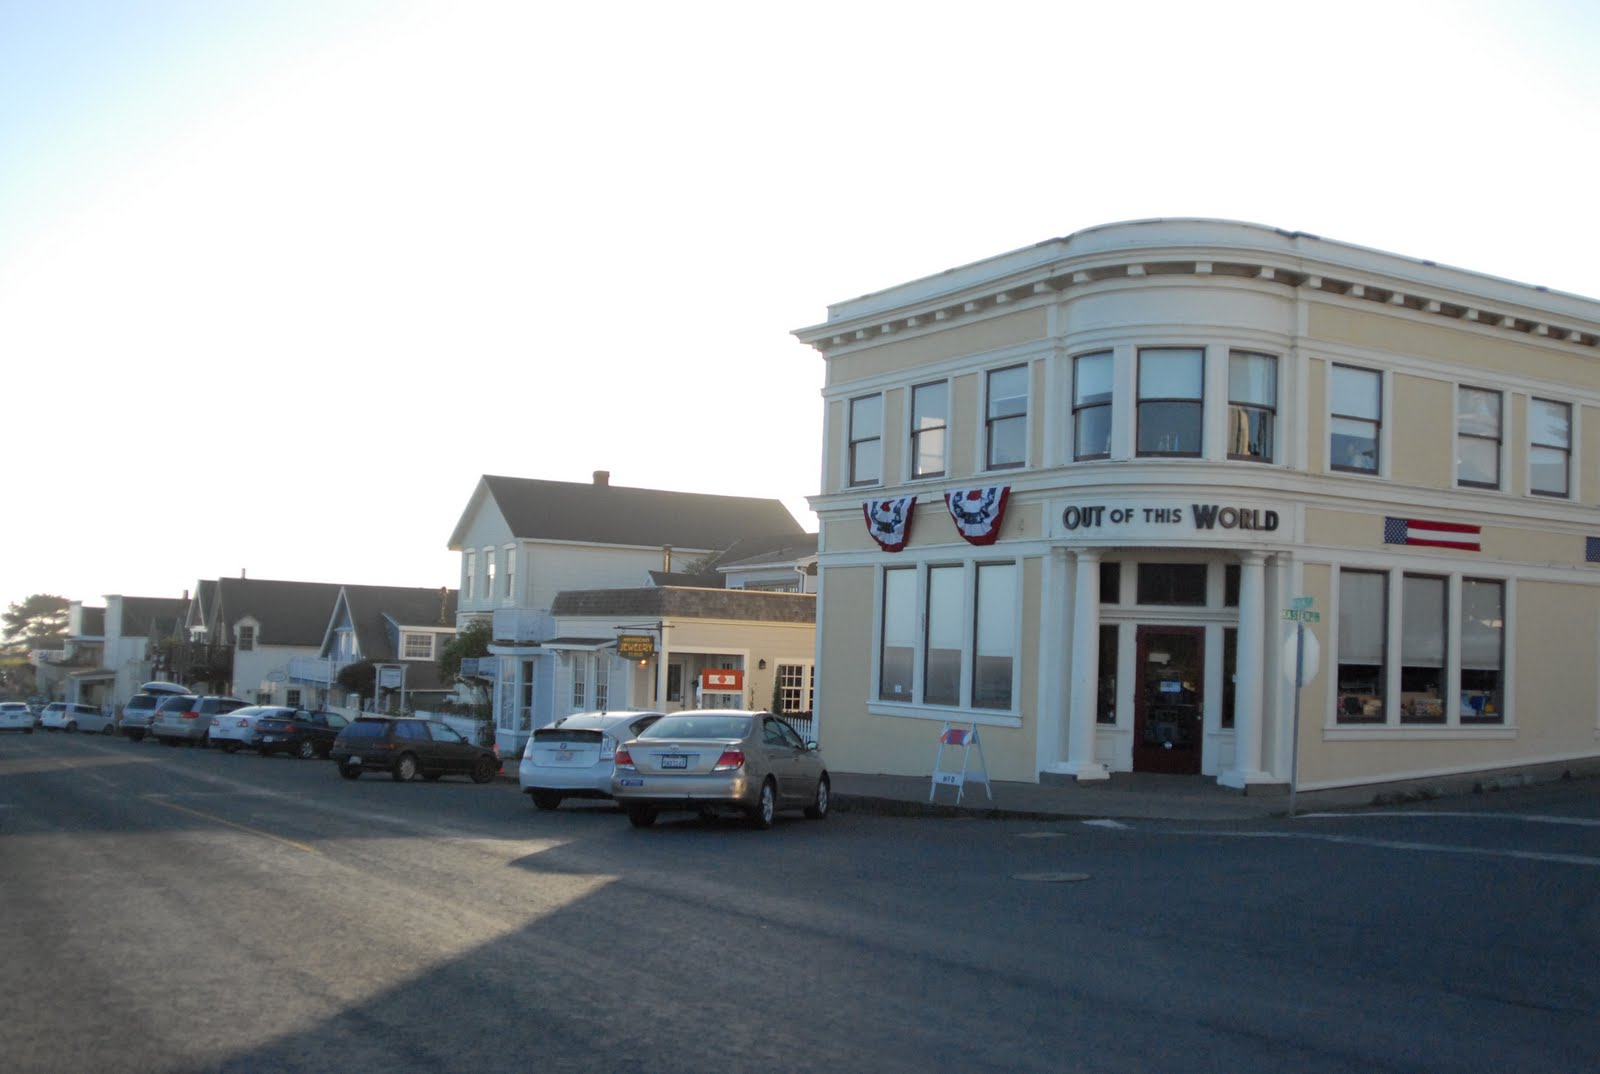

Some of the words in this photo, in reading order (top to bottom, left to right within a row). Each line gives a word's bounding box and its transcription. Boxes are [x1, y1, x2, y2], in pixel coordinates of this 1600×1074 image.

[1063, 506, 1106, 531] OUT
[1110, 508, 1134, 524] OF
[1142, 508, 1182, 524] THIS
[1192, 504, 1279, 532] WORLD
